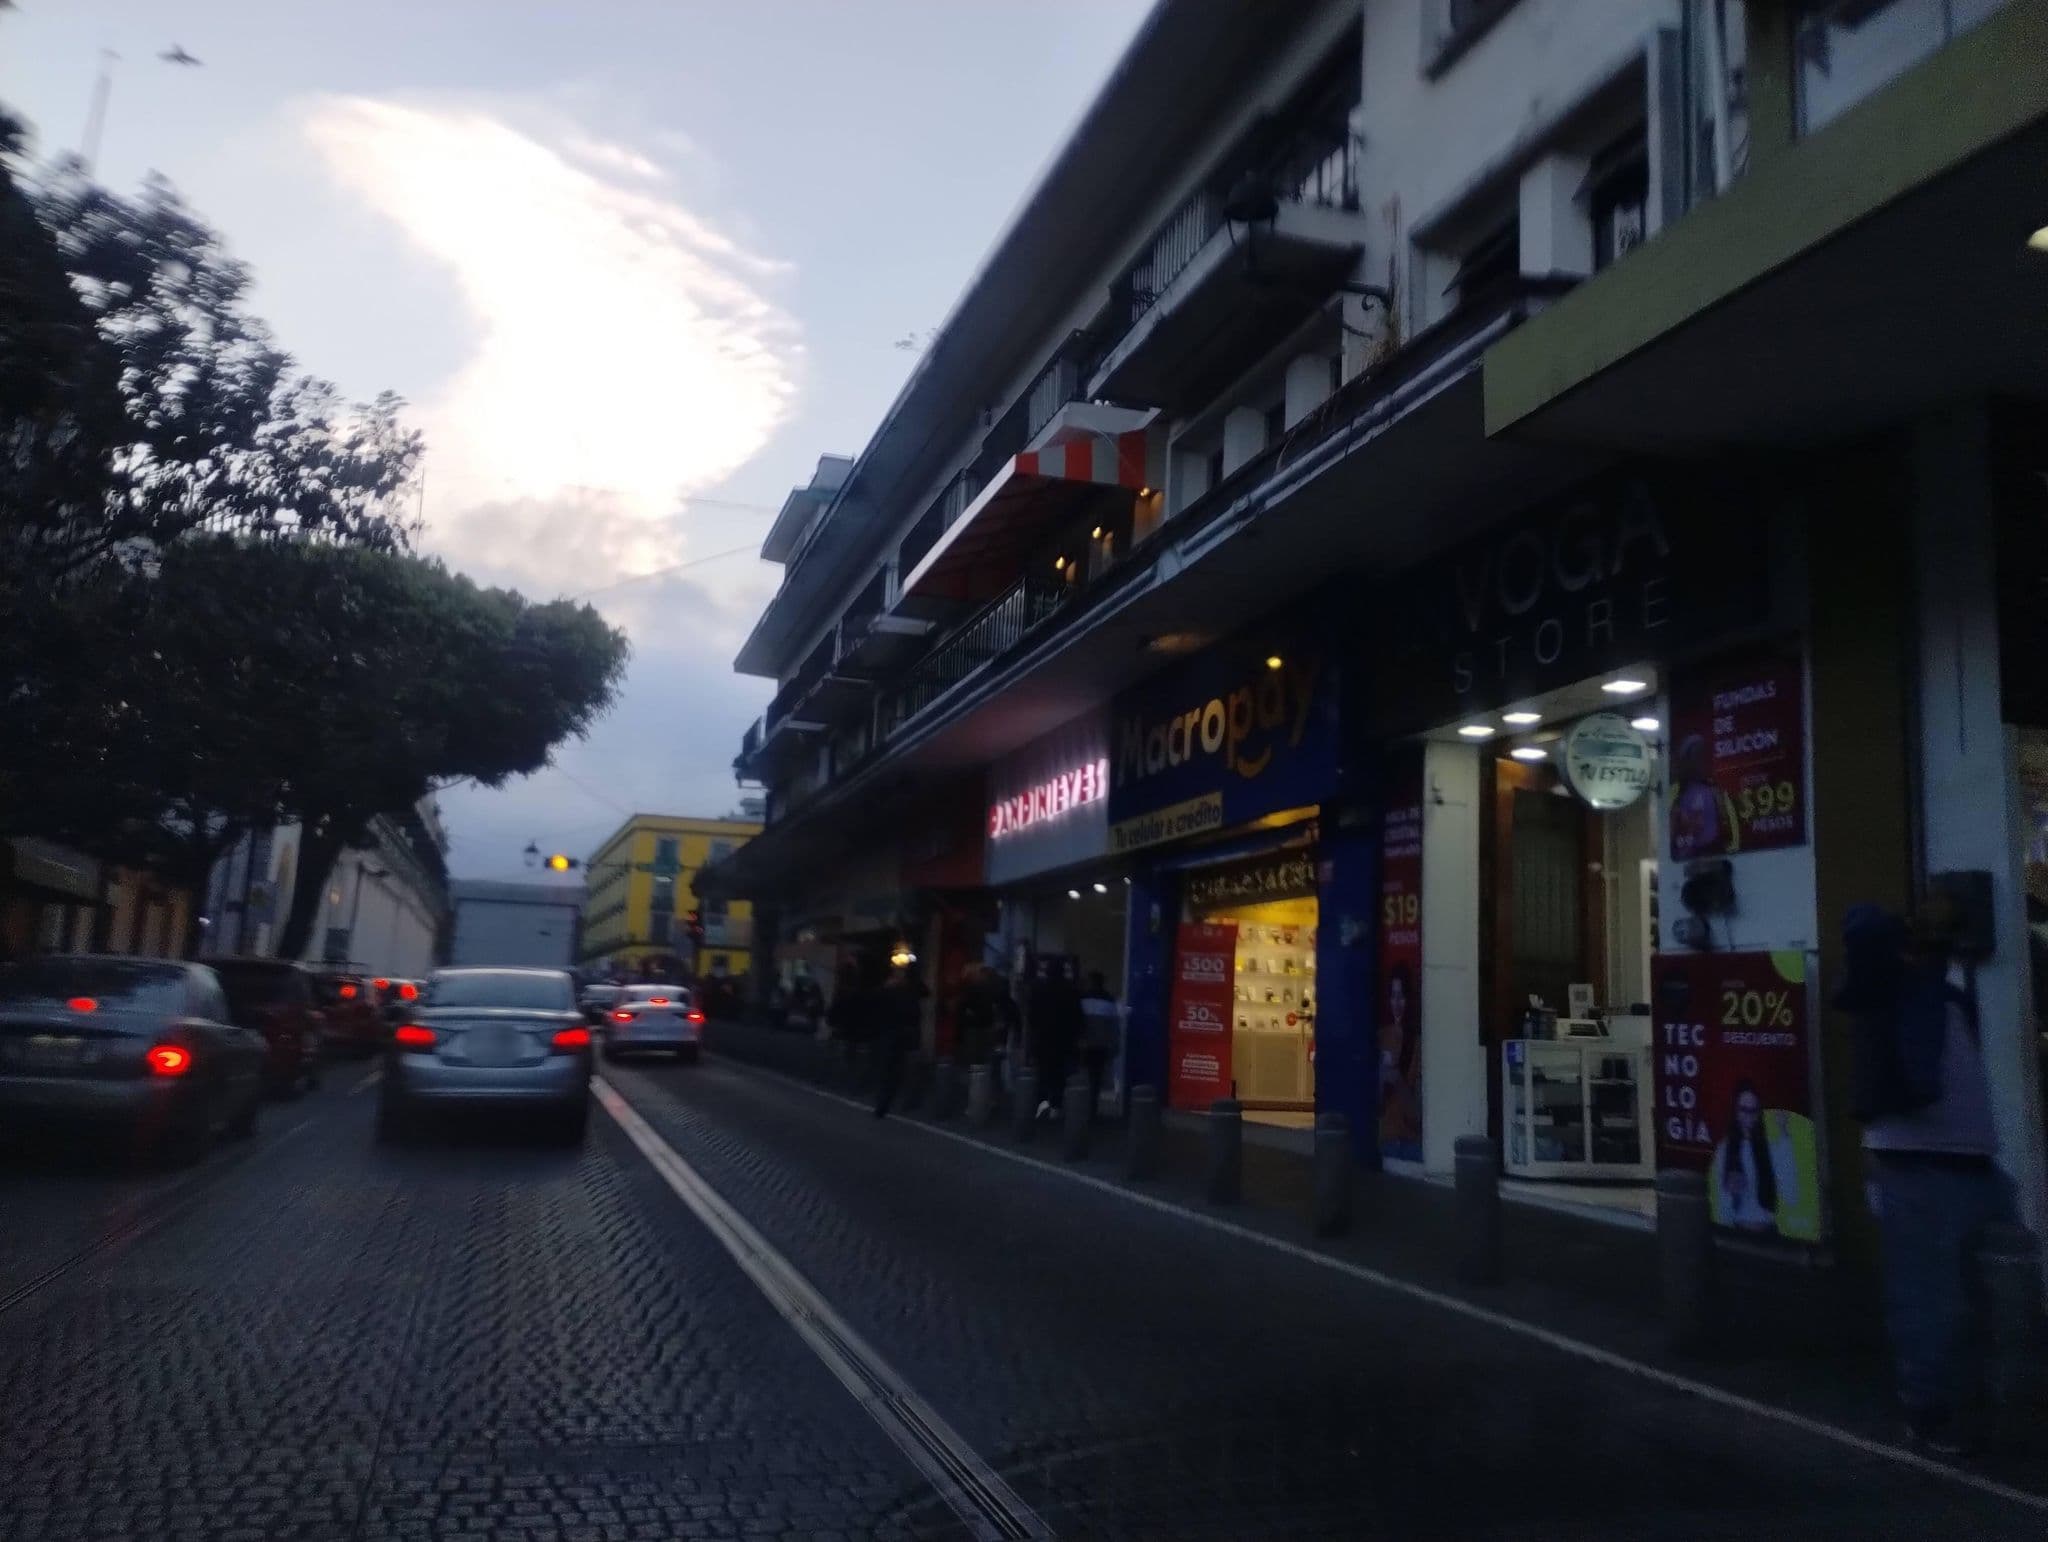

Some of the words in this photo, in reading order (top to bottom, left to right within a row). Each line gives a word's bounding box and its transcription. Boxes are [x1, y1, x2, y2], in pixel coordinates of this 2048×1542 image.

[1454, 577, 1670, 694] STORE
[1116, 657, 1320, 787] Macropay
[1739, 781, 1795, 820] $99
[1383, 894, 1418, 926] $19
[1721, 990, 1794, 1026] 20%
[1664, 1023, 1705, 1046] TEC
[1664, 1054, 1699, 1078] NO
[1665, 1086, 1697, 1109] LO
